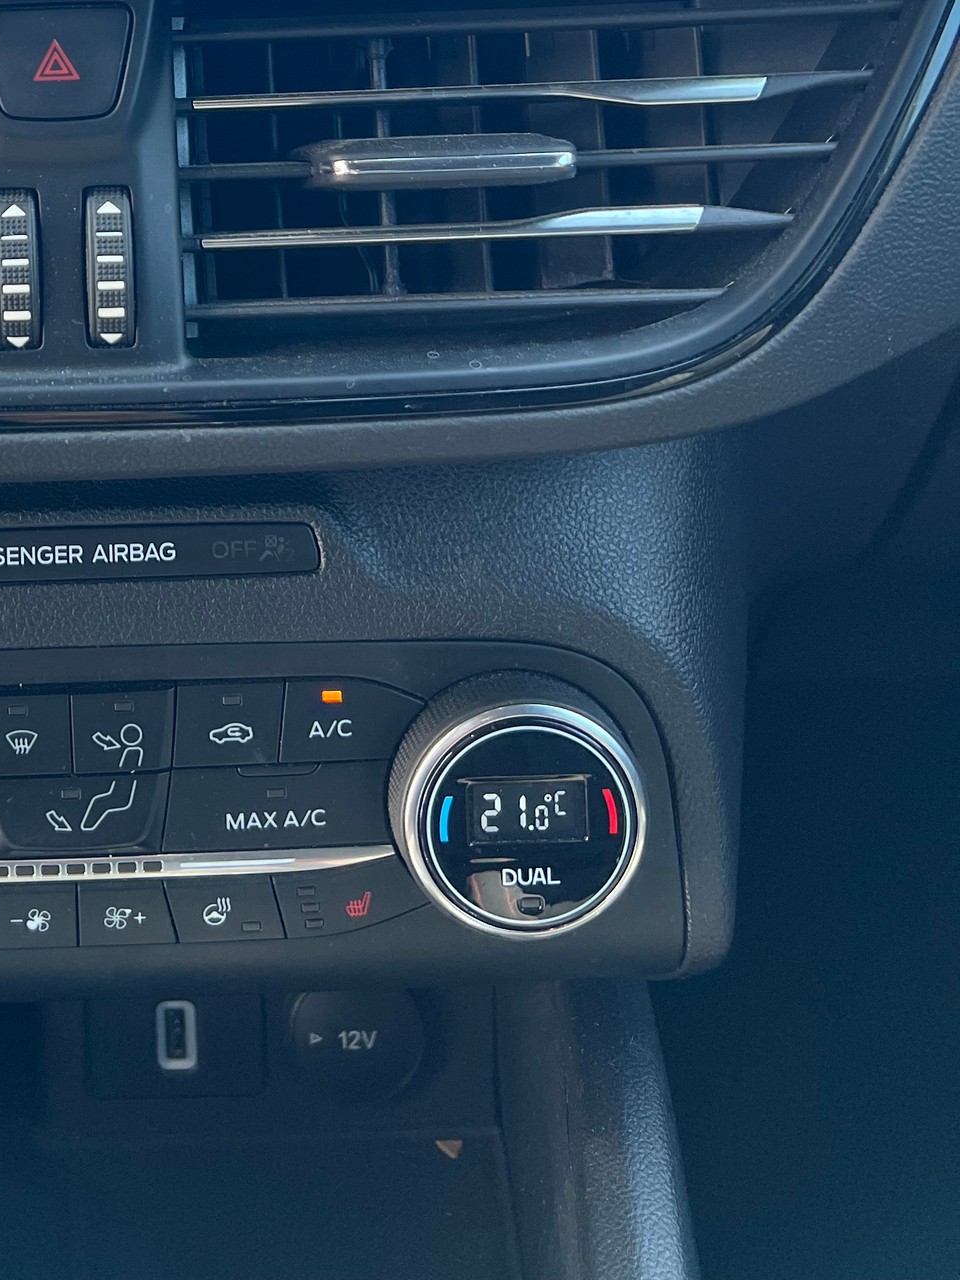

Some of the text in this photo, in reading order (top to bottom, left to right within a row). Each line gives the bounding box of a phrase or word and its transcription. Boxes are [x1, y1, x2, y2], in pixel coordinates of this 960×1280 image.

[91, 542, 177, 564] AIRBAG
[212, 540, 257, 559] OFF
[308, 720, 353, 739] A/C
[225, 808, 327, 831] MAX A/C
[501, 867, 562, 887] DUAL
[338, 1030, 378, 1050] 12V
